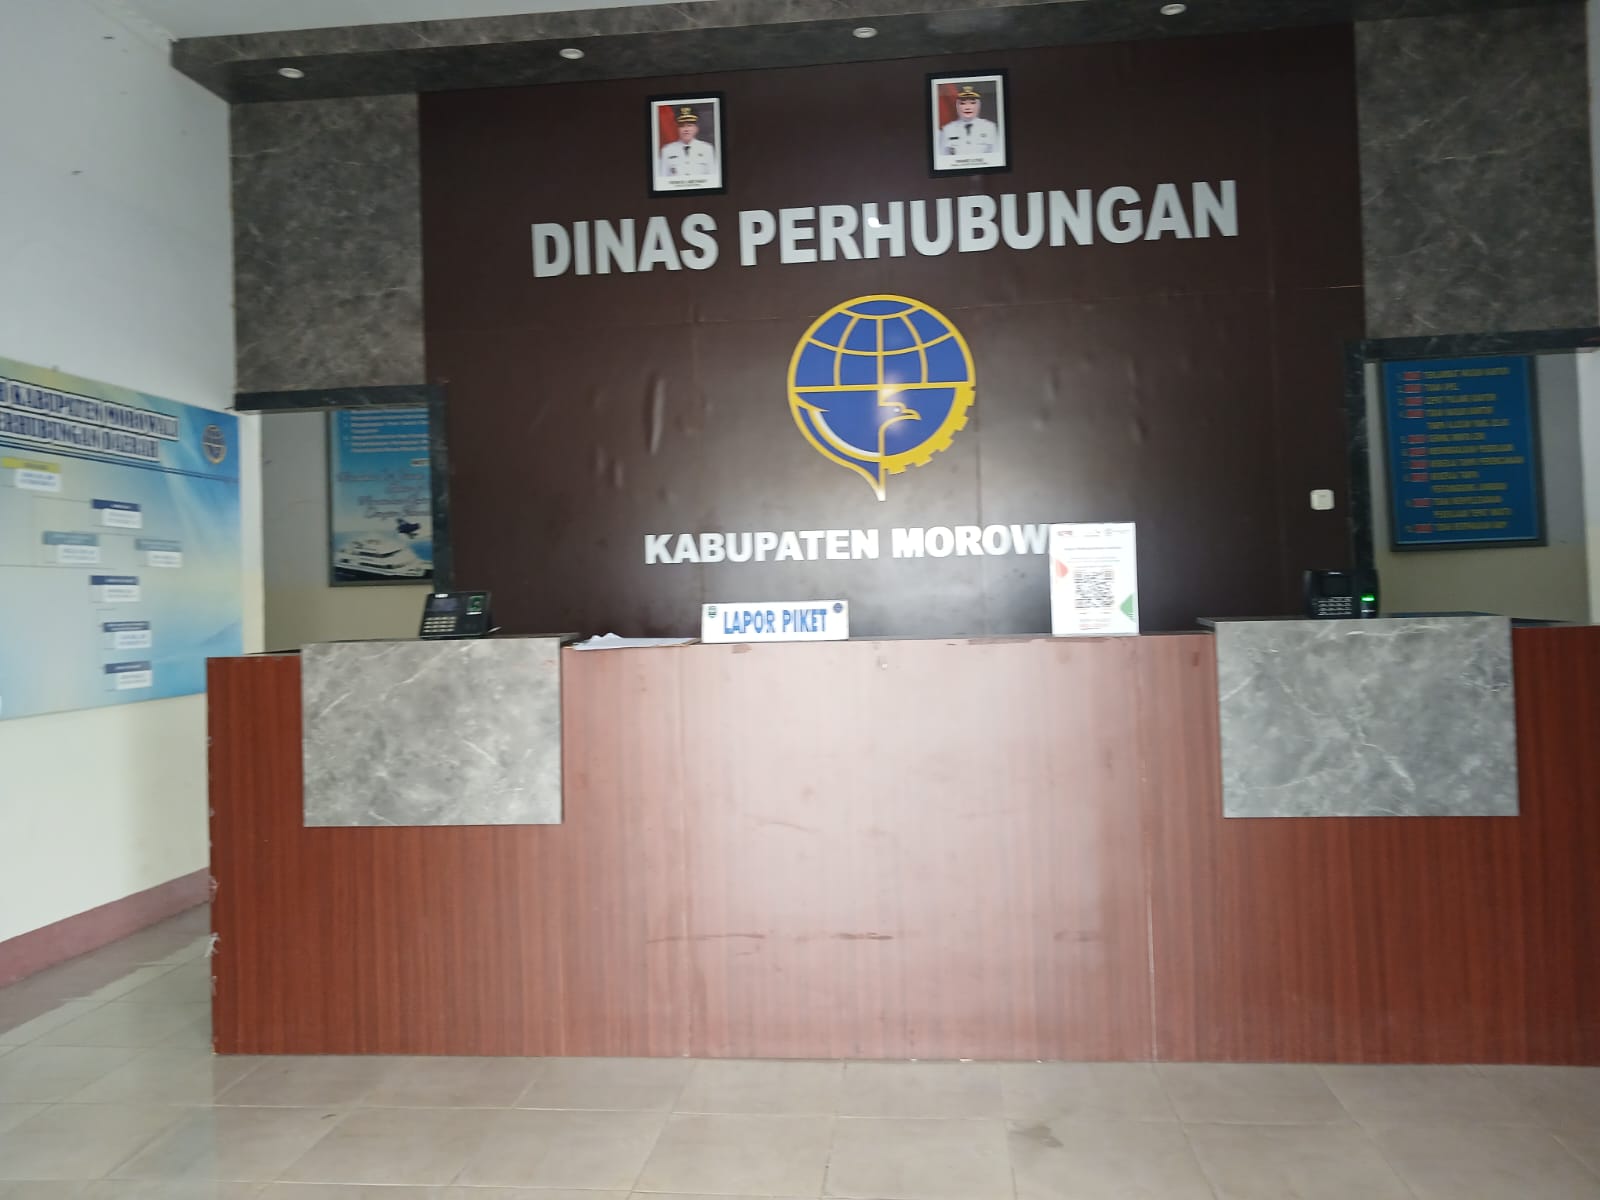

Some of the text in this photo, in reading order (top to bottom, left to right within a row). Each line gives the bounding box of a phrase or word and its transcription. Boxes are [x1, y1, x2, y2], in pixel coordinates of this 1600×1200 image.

[532, 180, 1238, 278] DINAS PERHUBUNGAN
[0, 411, 98, 449] ERHUBUNGAN
[645, 523, 1050, 565] KABUPATEN MOROW
[723, 608, 828, 635] LAPOR PIKET
